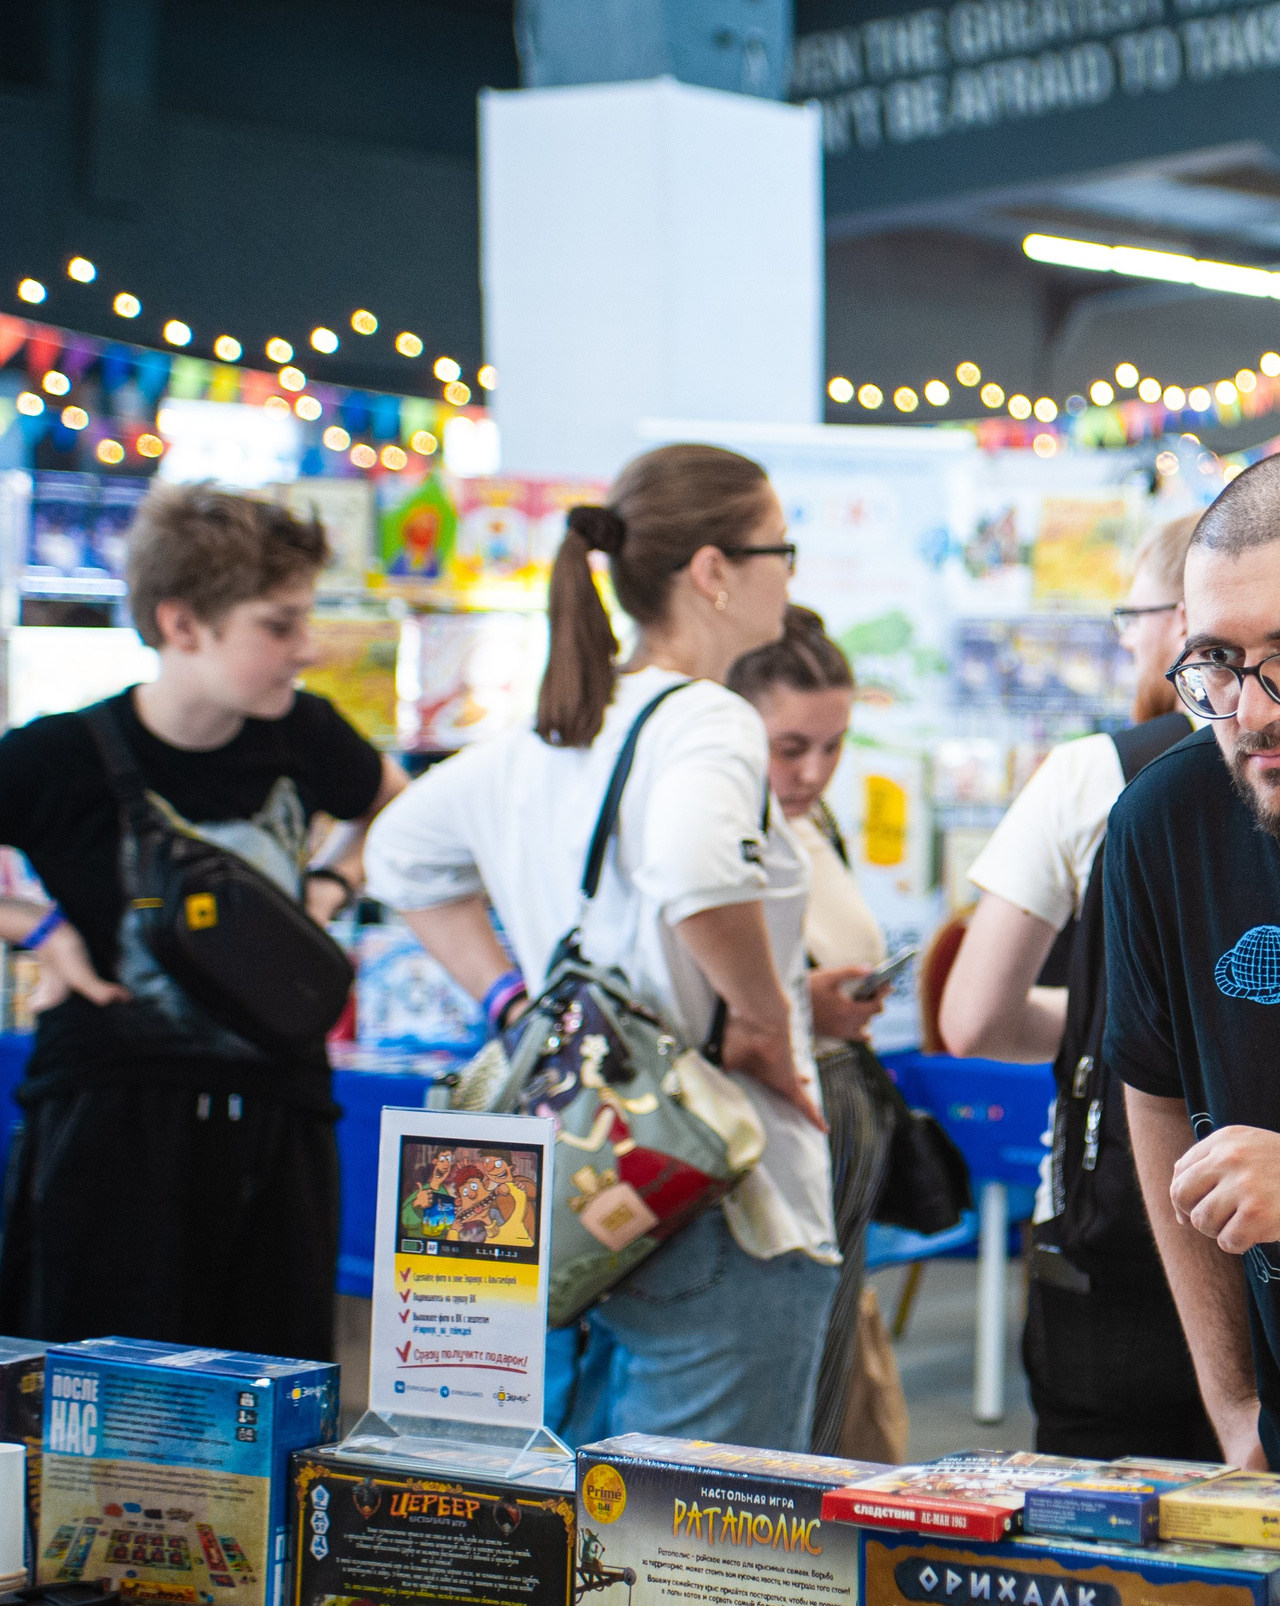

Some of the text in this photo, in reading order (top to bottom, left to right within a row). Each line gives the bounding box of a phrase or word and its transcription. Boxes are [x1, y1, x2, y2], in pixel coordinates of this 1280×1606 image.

[1118, 26, 1182, 93] TO
[414, 1348, 529, 1367] Сразу получите подарок!
[52, 1374, 99, 1402] ПОСЛЕ
[50, 1400, 98, 1456] НАС
[587, 1484, 622, 1501] Primé
[701, 1486, 794, 1509] НАСТОЛЬНАЯ ИГРА
[390, 1492, 480, 1520] ЦЕРБЕР
[673, 1498, 823, 1555] РАТАПОЛИС
[951, 1515, 967, 1529] 1963
[722, 1558, 741, 1567] место
[812, 1569, 834, 1581] Борьба
[647, 1574, 671, 1586] Вашему
[672, 1579, 703, 1591] семейству
